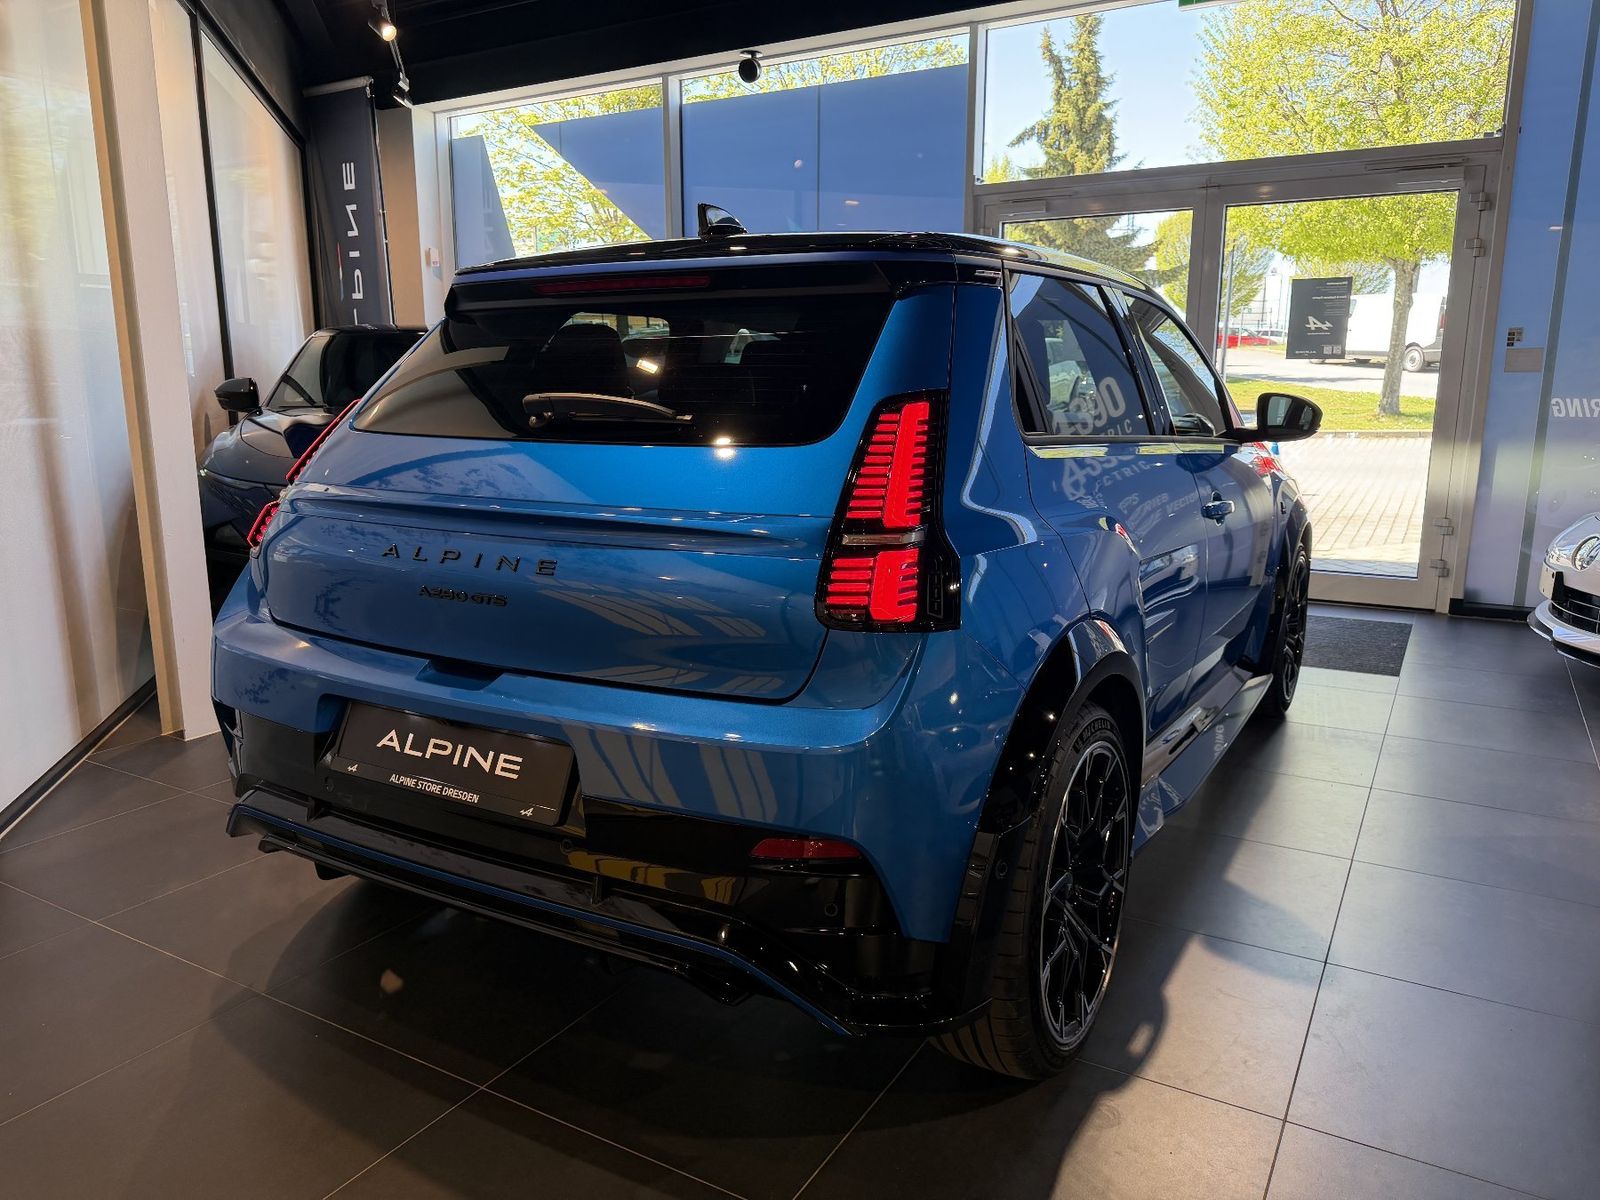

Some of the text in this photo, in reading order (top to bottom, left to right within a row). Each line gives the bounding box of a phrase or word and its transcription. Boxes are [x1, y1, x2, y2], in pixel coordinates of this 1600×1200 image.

[382, 543, 557, 576] ALPINE
[376, 729, 523, 779] ALPINE
[389, 773, 480, 803] ALPINE STORE DRESDEN
